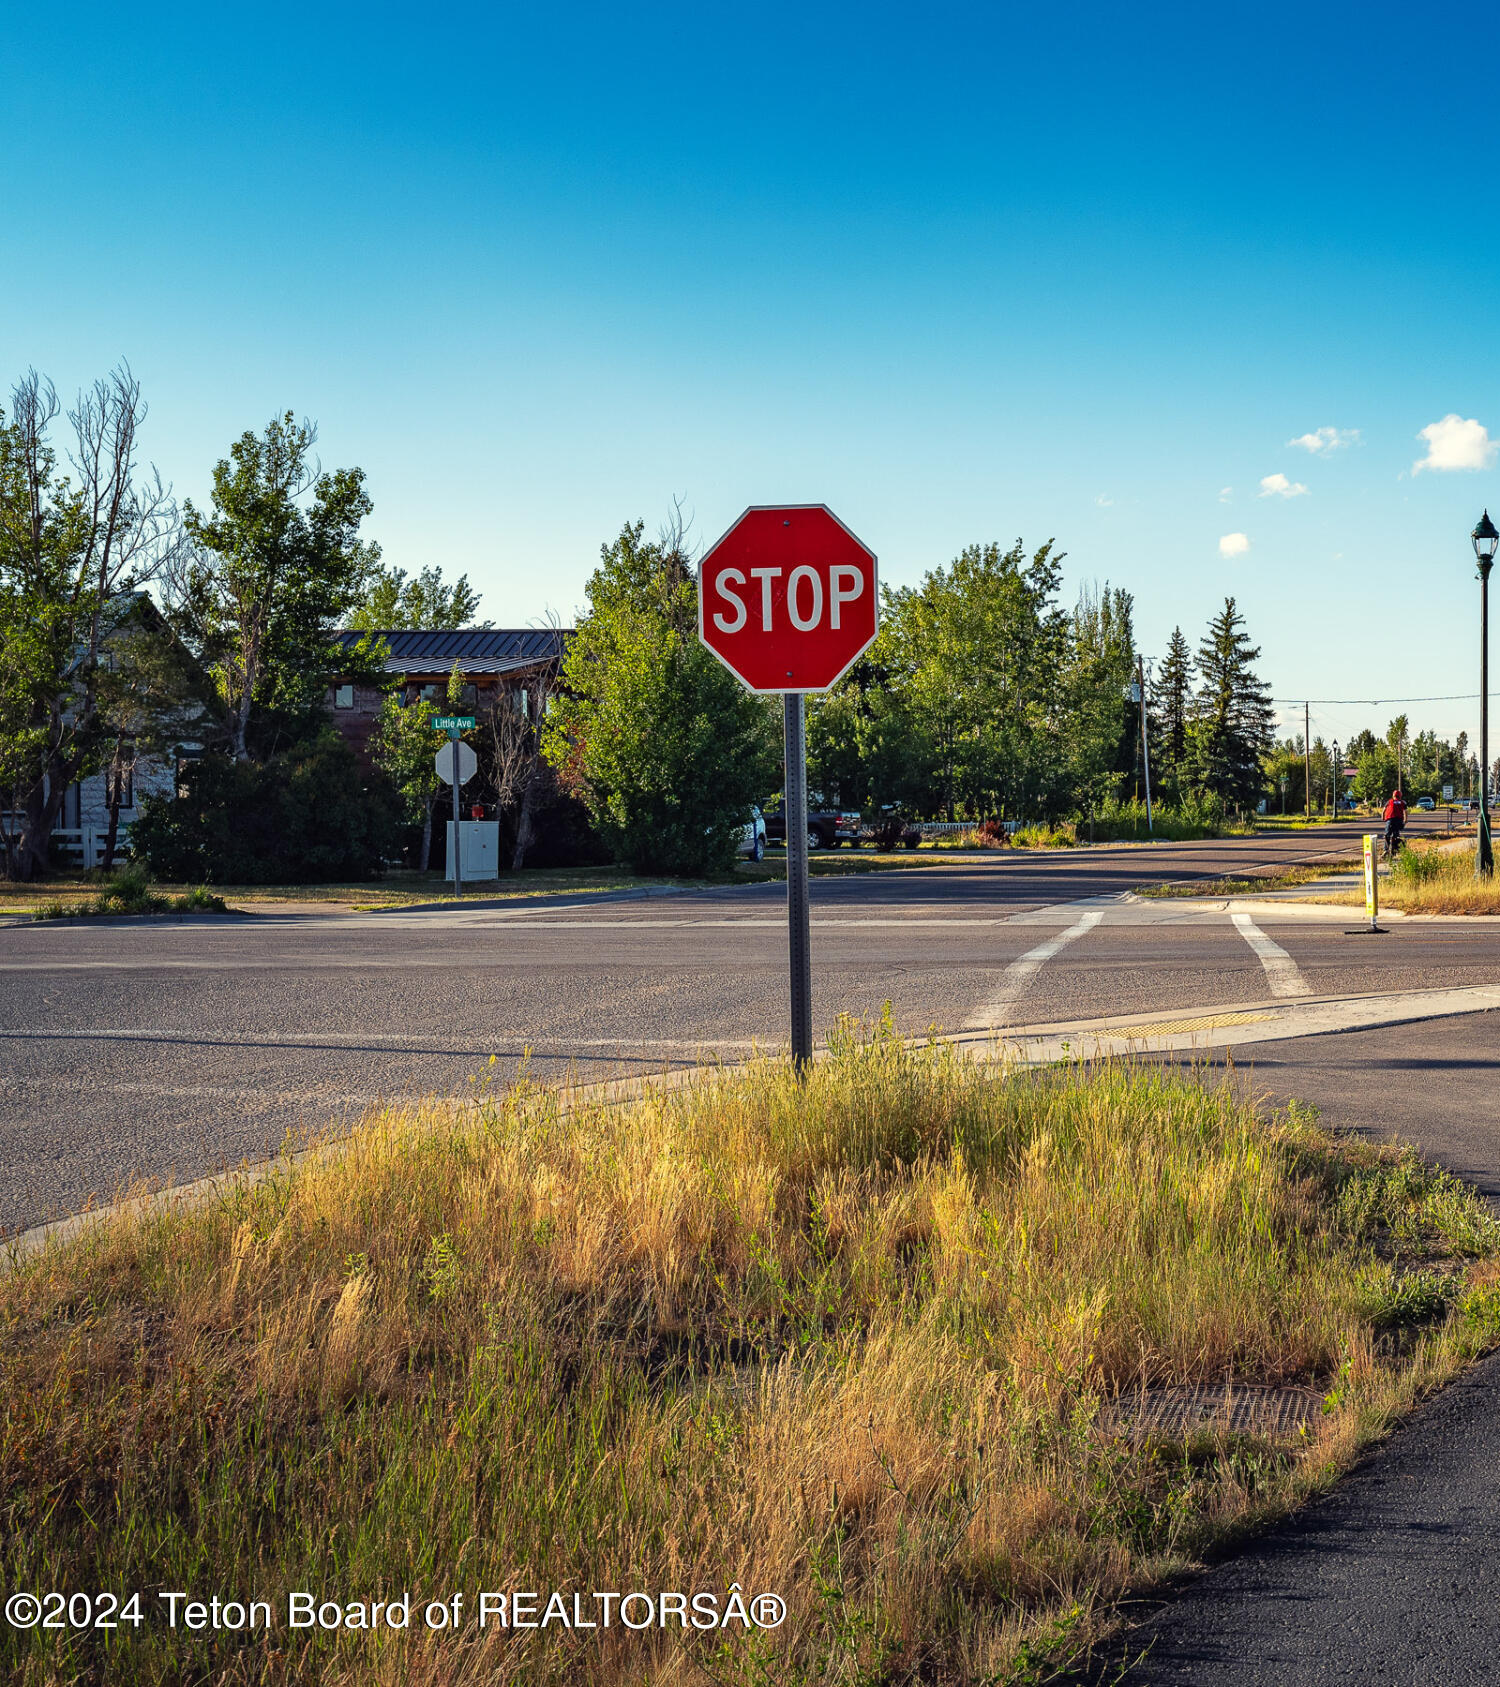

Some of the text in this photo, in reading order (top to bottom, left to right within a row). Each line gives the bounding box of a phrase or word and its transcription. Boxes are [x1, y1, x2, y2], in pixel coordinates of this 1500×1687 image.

[713, 564, 864, 634] STOP
[435, 718, 472, 728] Little Ave
